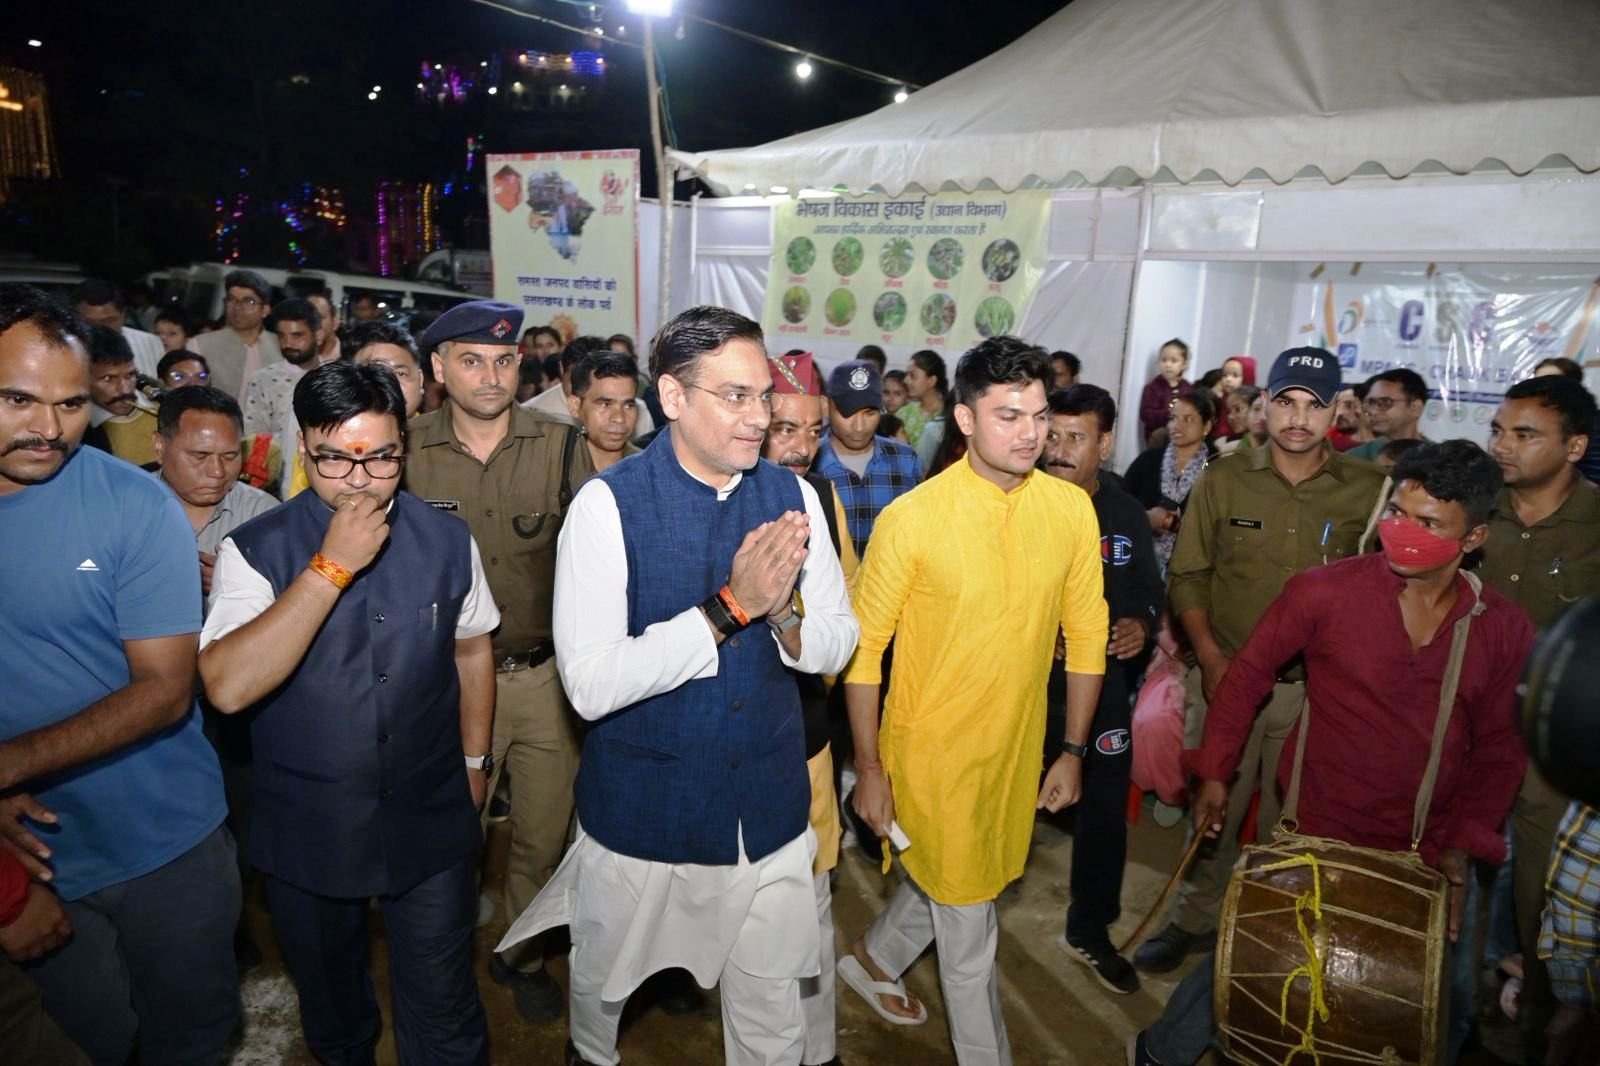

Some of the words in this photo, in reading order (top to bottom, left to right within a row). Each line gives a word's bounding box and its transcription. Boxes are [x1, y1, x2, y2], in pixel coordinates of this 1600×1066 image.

[834, 197, 879, 217] विकास
[884, 196, 926, 219] इकाई
[930, 201, 963, 220] (उद्यान
[967, 201, 1006, 220] विभाग)
[543, 277, 570, 288] जनपद
[572, 276, 601, 290] वासियों
[577, 296, 596, 309] लोक
[1288, 356, 1323, 368] PRD
